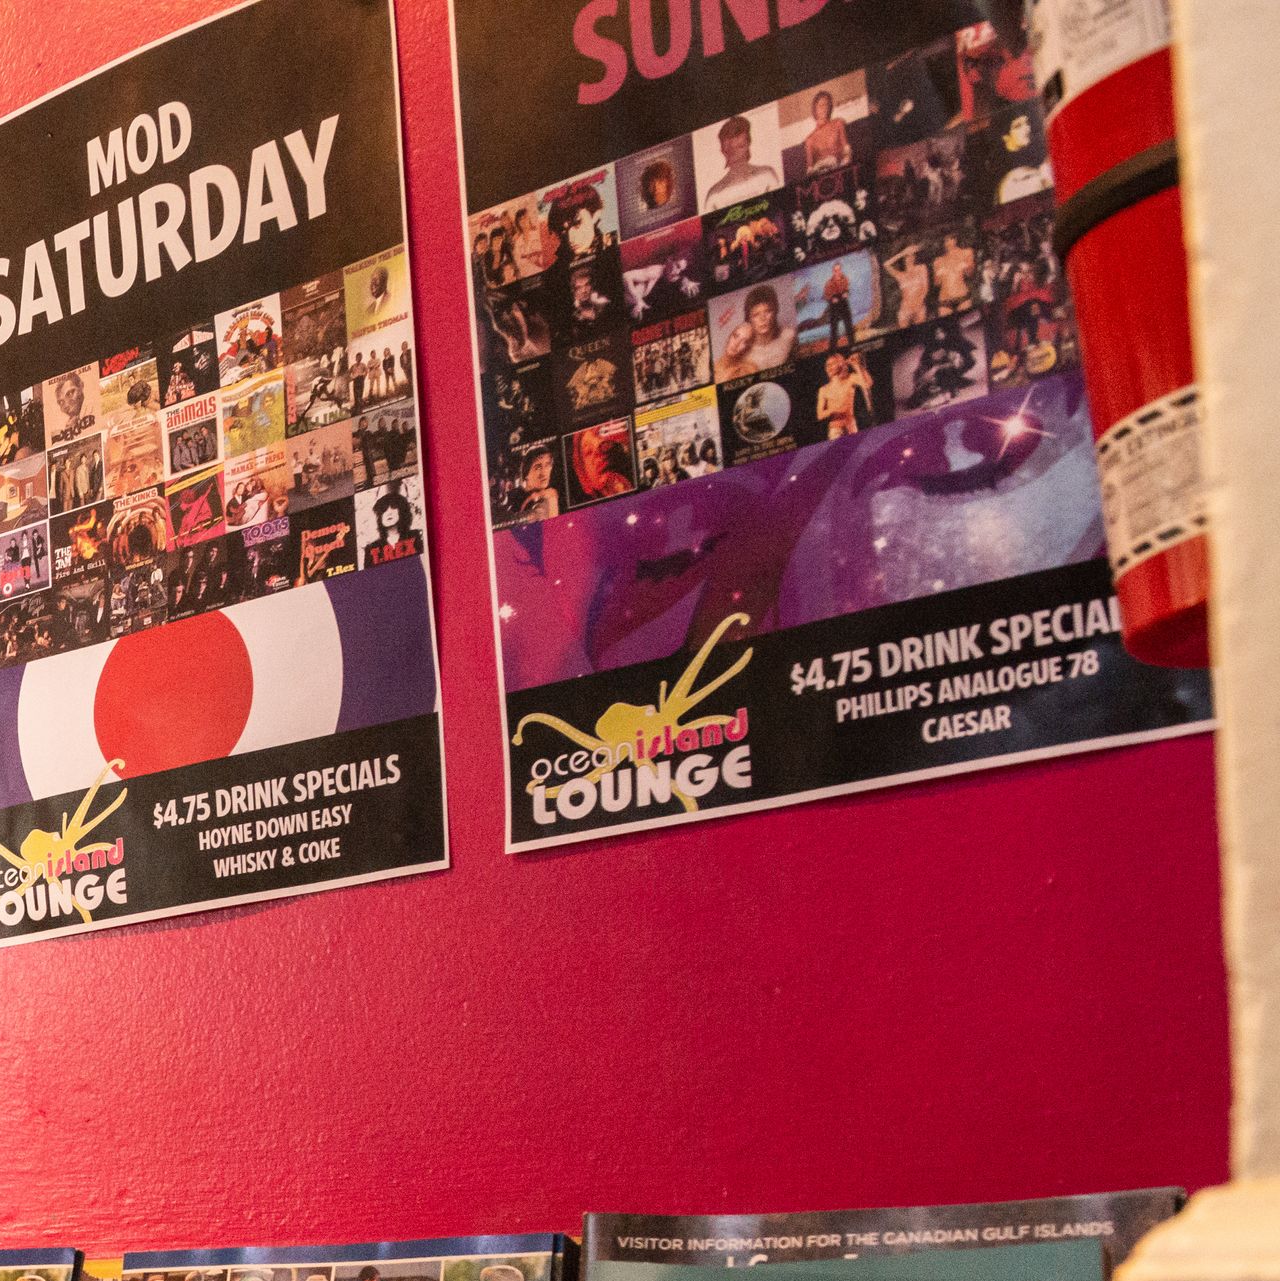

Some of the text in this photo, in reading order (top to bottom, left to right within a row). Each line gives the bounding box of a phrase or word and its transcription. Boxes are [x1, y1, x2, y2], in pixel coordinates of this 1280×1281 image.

[87, 100, 192, 197] MOD
[790, 645, 872, 697] $4.75
[876, 626, 984, 679] DRINK
[835, 648, 1100, 724] PHILLIPS ANALOGUE 78
[922, 705, 1012, 746] CAESAR
[530, 744, 753, 826] LOUNGE
[197, 803, 353, 851] HOYNE DOWN EASY
[213, 838, 341, 880] WHISKY & COKE
[616, 1220, 1114, 1251] VISITOR INFORMATION FOR THE CANADIAN GULF ISLANDS
